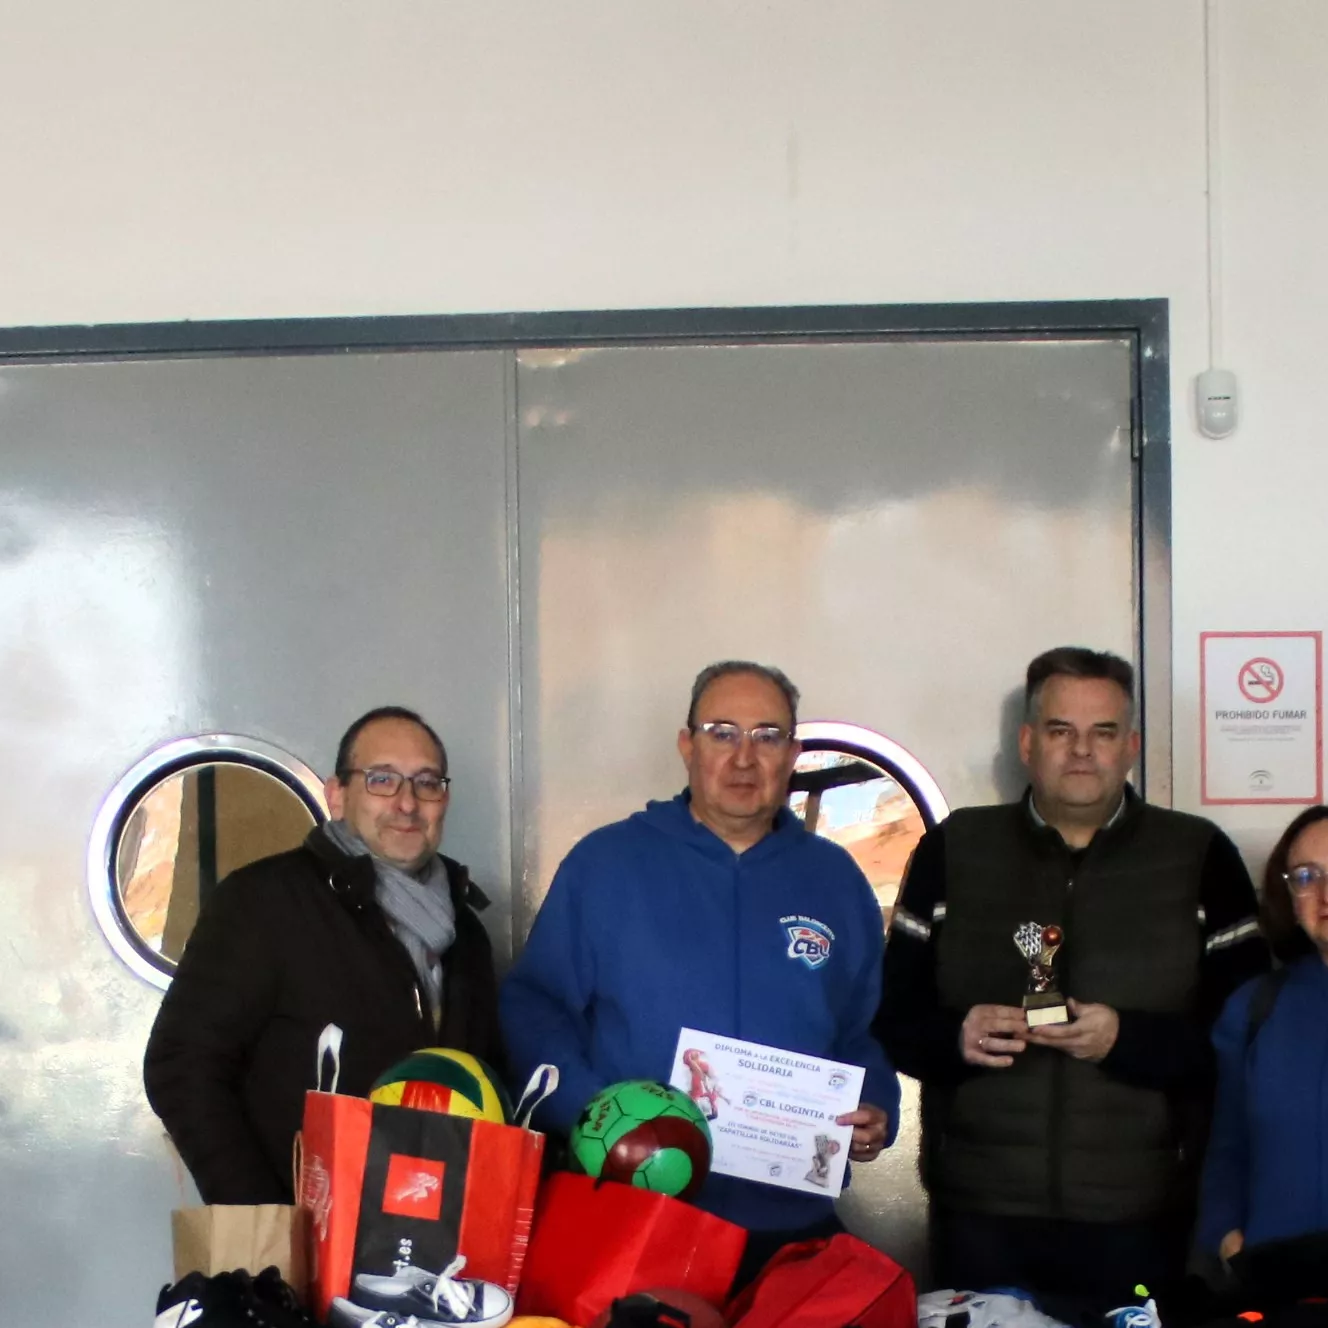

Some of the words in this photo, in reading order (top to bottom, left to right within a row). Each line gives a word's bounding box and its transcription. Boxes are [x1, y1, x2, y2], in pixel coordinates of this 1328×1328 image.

[1215, 710, 1270, 719] PROHIBIDO
[1272, 710, 1308, 719] FUMAR
[714, 1042, 753, 1057] DIPLOMA
[769, 1054, 822, 1073] EXCELENCIA
[738, 1058, 794, 1079] SOLIDARIA
[759, 1099, 777, 1109] CBL
[392, 1237, 413, 1272] t.es
